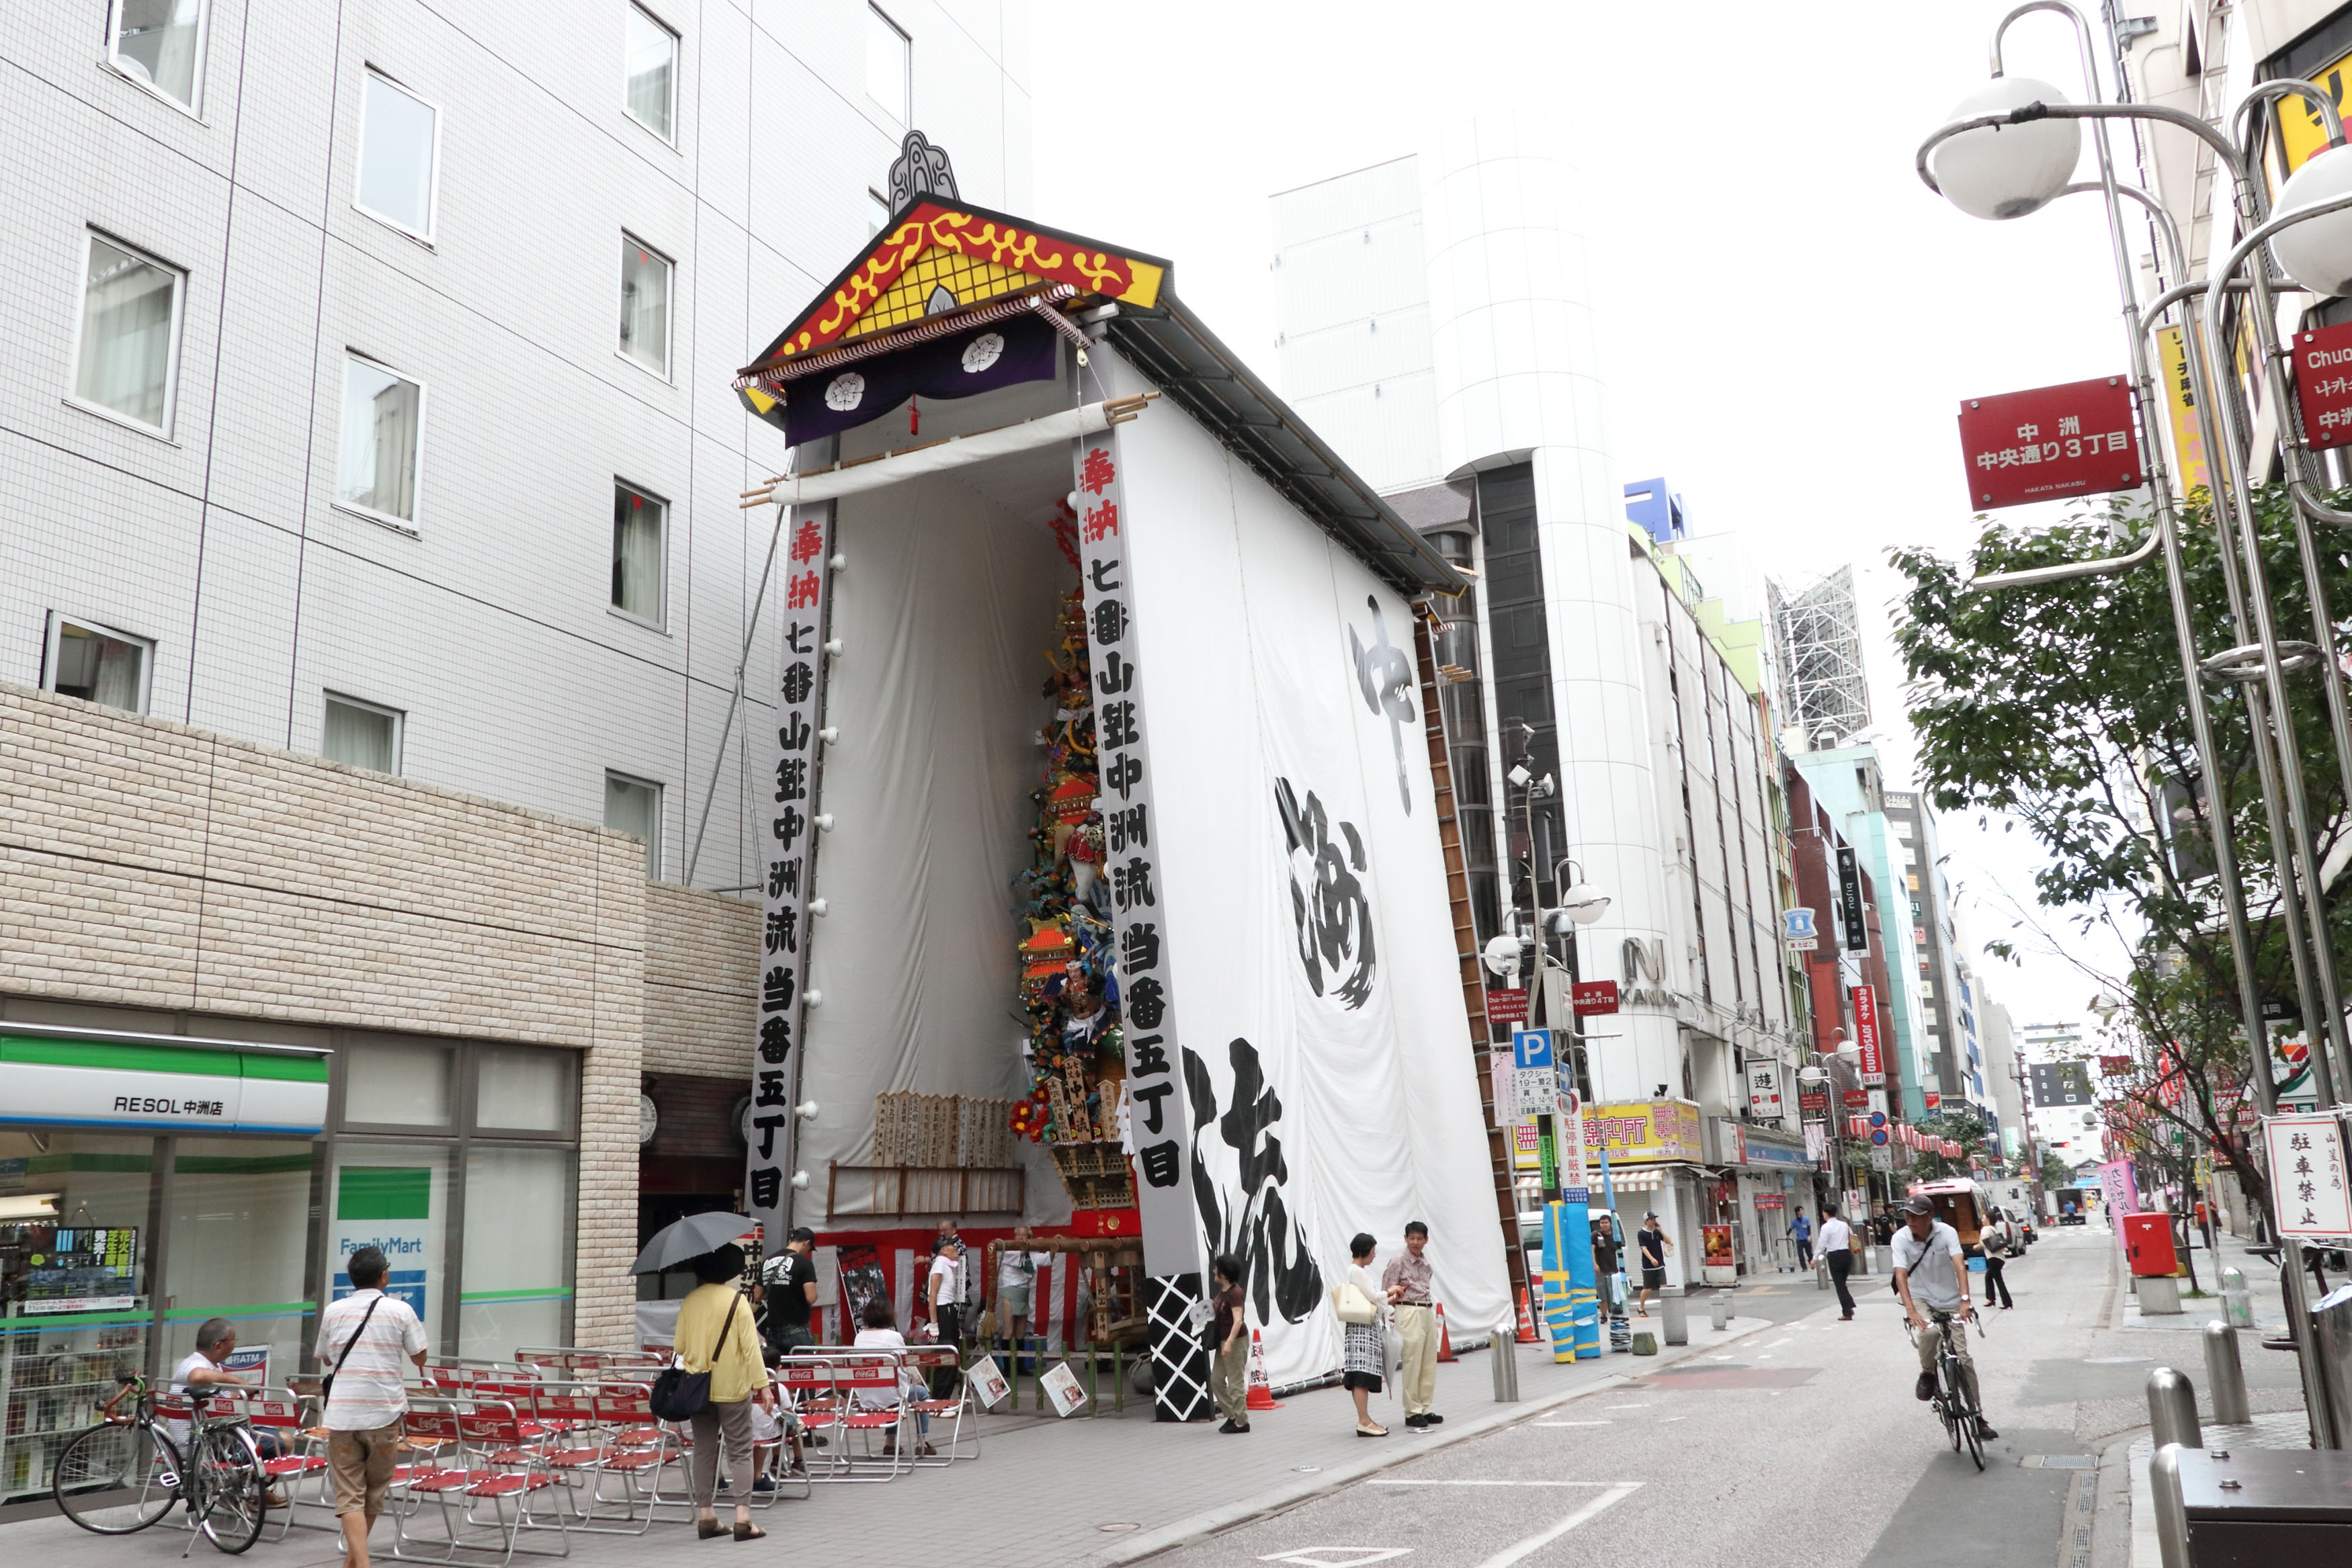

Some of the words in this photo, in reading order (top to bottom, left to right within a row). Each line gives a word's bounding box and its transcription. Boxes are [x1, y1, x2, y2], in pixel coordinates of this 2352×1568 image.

[2017, 415, 2081, 442] 中洲
[1976, 431, 2128, 470] 中央通り3丁目
[2025, 484, 2054, 494] HAKATA
[2055, 480, 2086, 489] NAKASU
[1858, 988, 1870, 1020] カラオケ
[1523, 1035, 1545, 1065] P
[1861, 1024, 1876, 1072] JOYSOUND
[1519, 1070, 1549, 1078] タクシー
[1564, 1117, 1581, 1186] 駐停車厳禁
[2290, 1133, 2318, 1225] 駐車禁止
[790, 1370, 813, 1380] Coca-Cola
[855, 1369, 876, 1379] Coca-Cola
